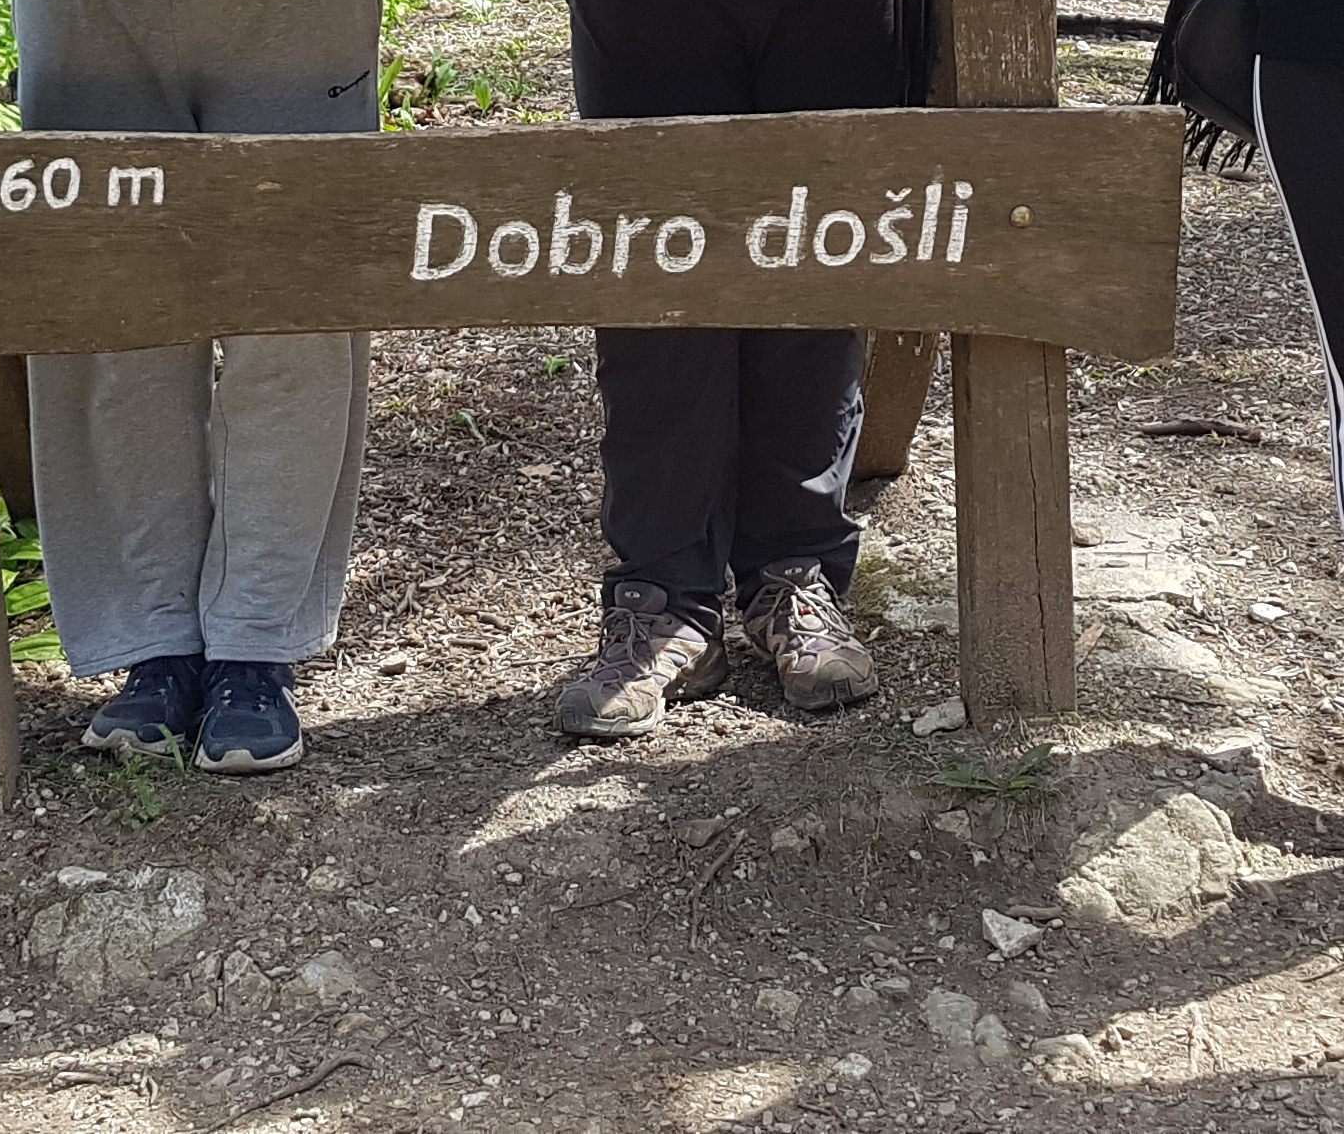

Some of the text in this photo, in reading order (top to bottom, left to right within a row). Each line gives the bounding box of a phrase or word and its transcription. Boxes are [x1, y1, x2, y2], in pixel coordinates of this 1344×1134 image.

[107, 165, 165, 207] m
[410, 180, 974, 281] Dobro došli
